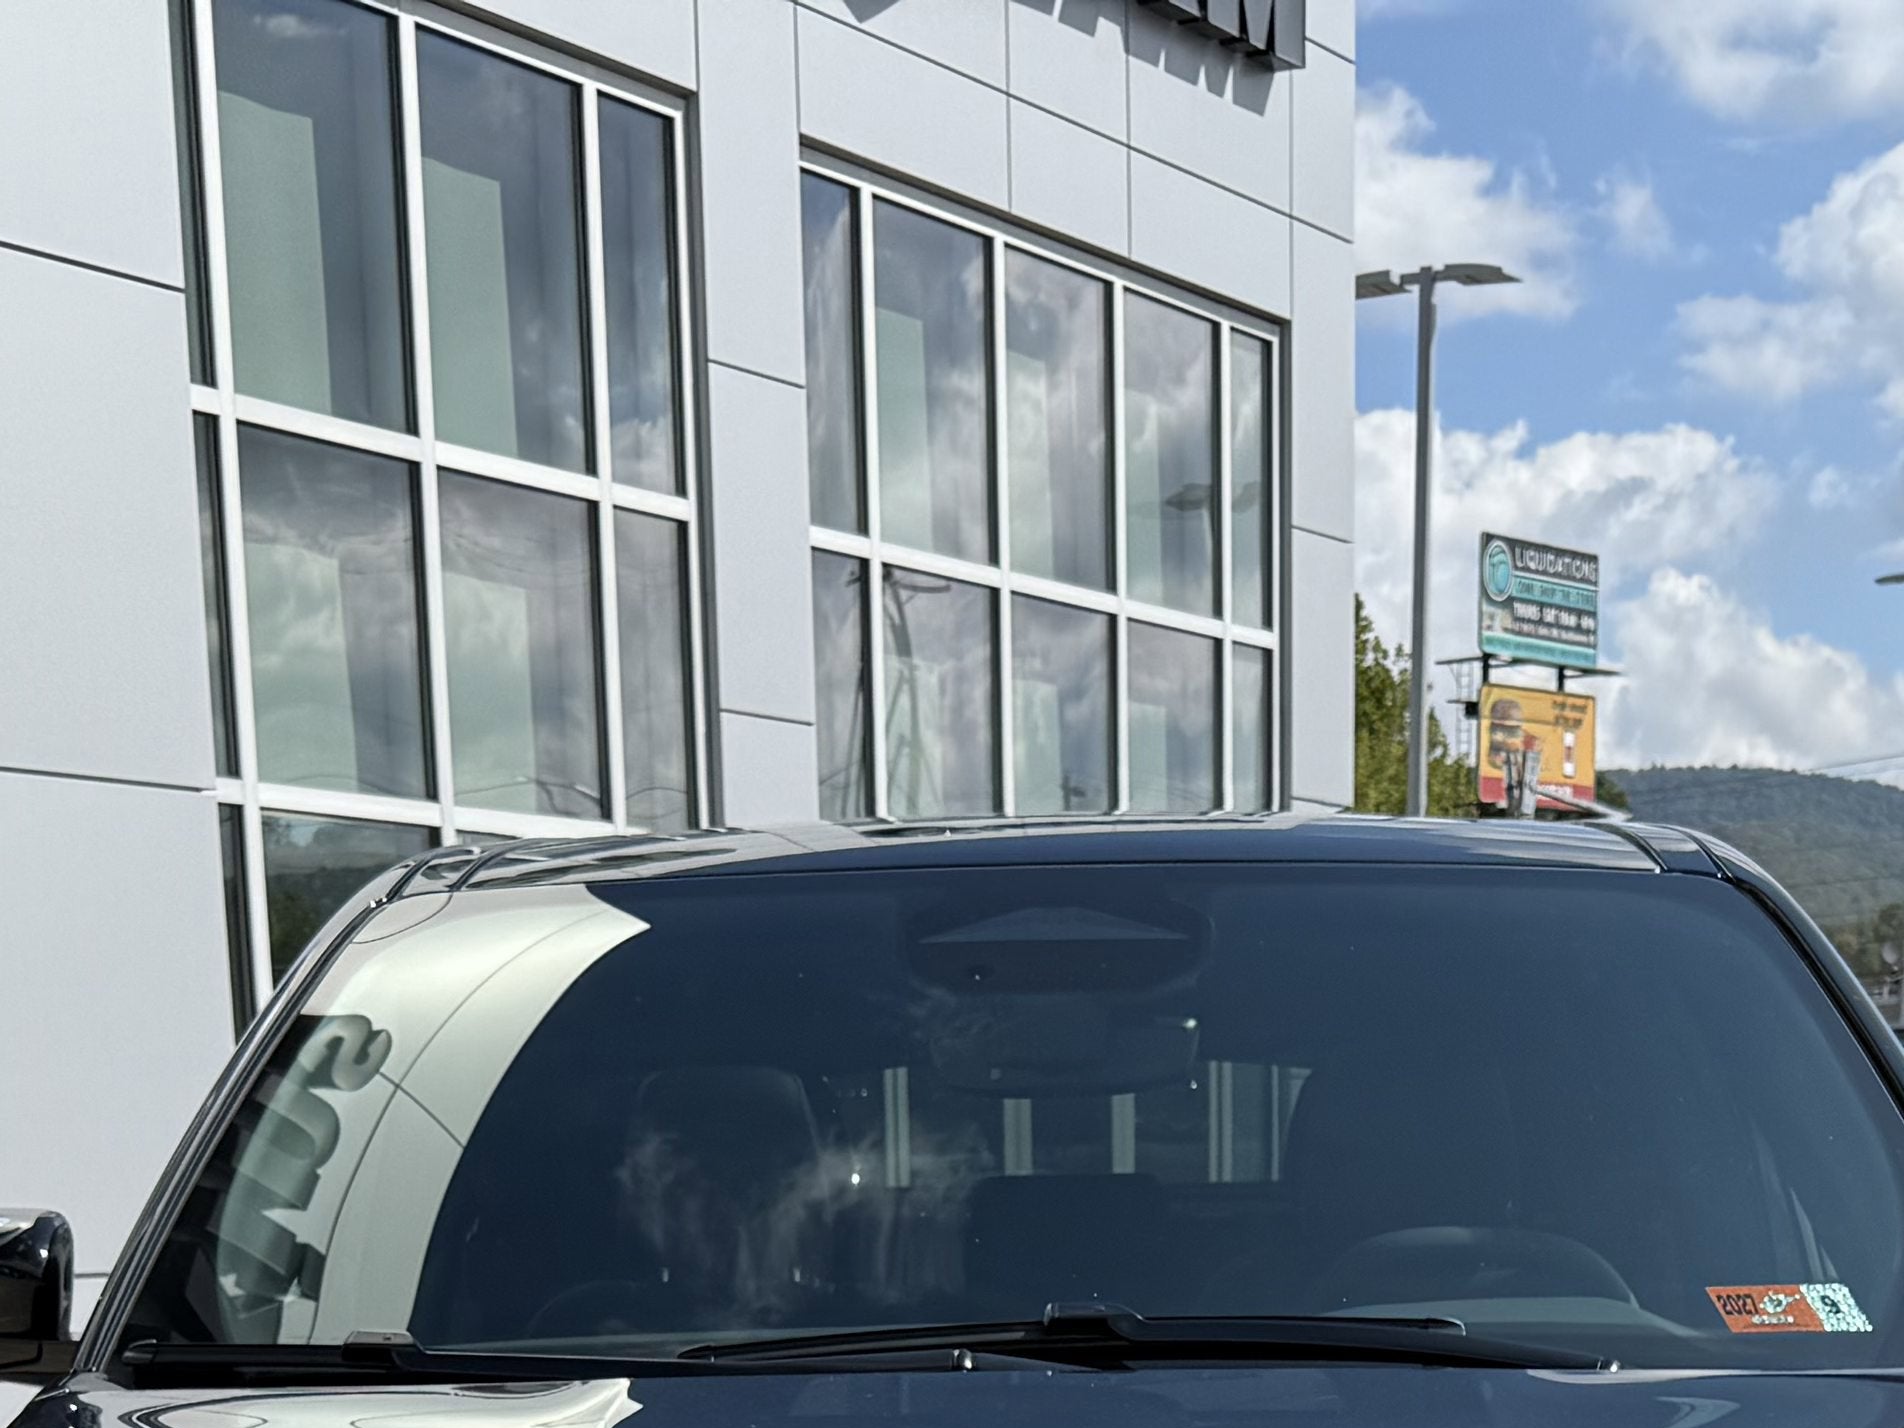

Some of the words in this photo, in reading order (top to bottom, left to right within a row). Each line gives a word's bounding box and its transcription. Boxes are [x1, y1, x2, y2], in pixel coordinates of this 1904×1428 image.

[1514, 546, 1597, 582] LIQUIDATIONS
[1716, 1294, 1758, 1316] 2027
[1820, 1295, 1842, 1315] 9
